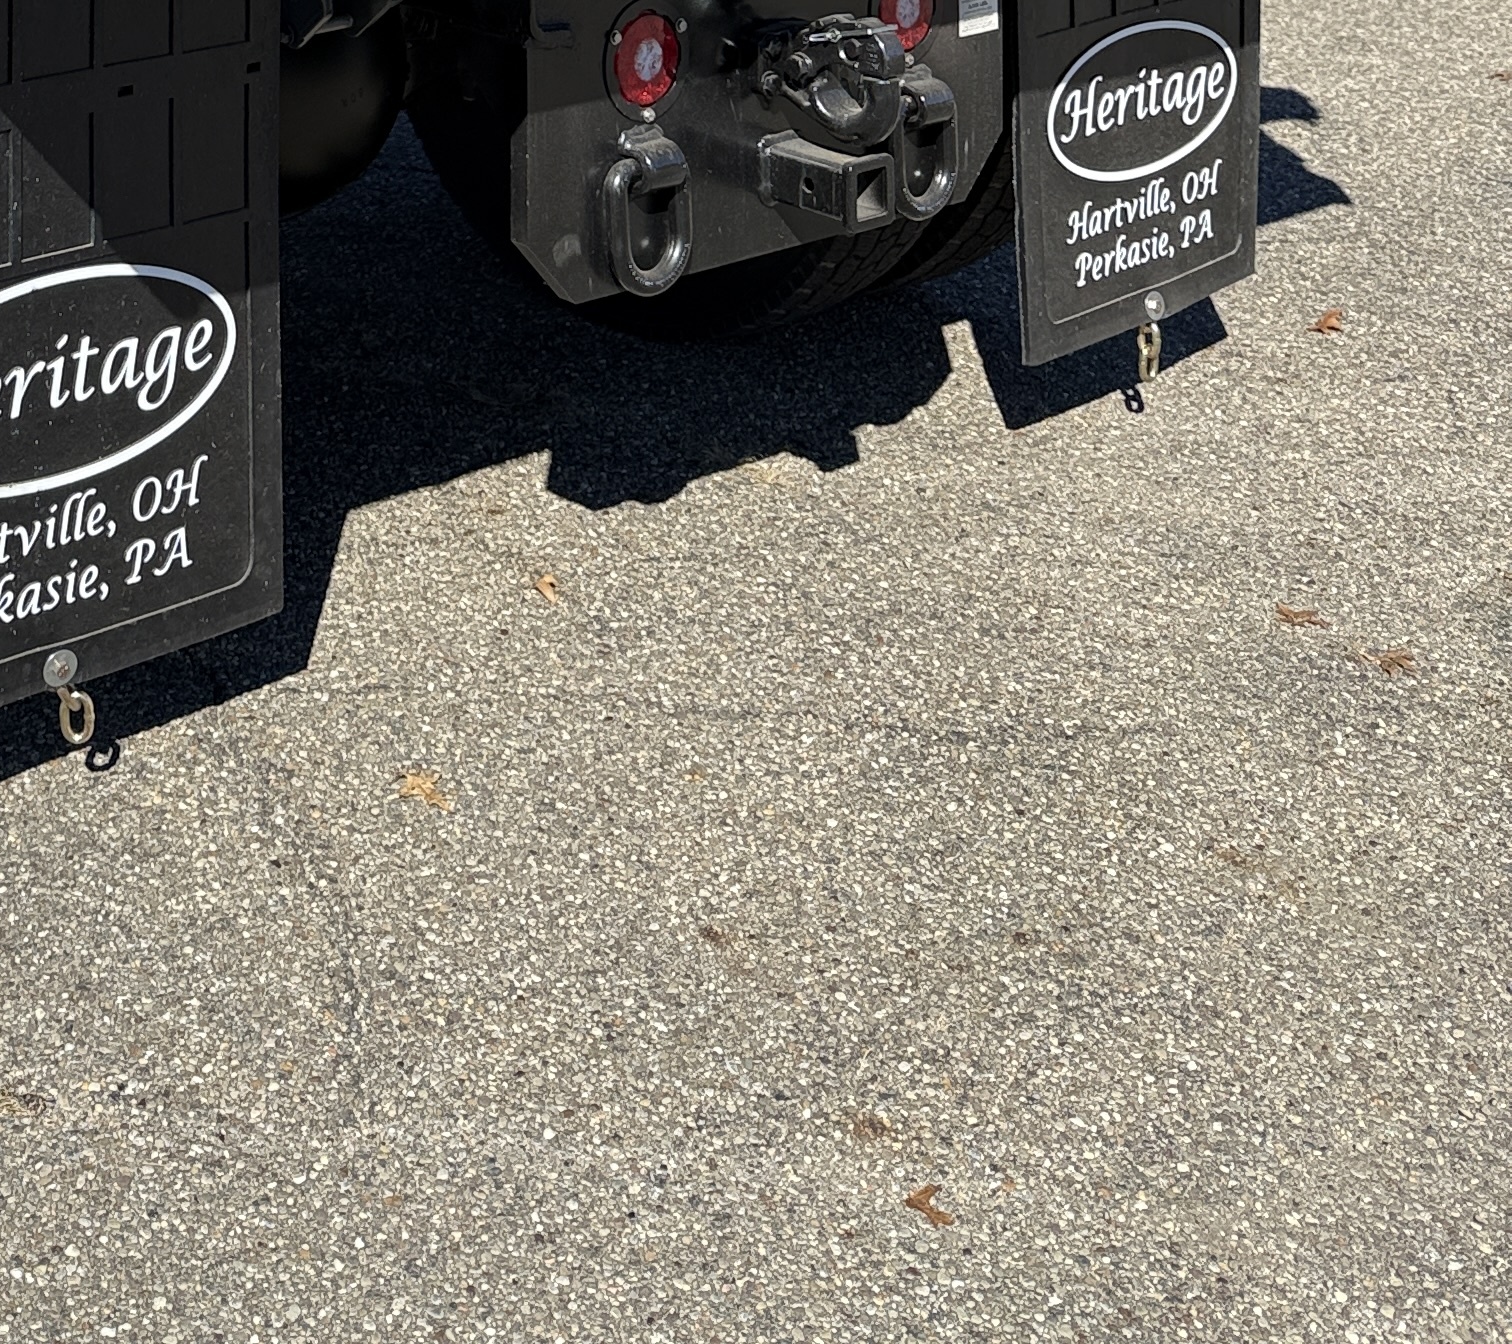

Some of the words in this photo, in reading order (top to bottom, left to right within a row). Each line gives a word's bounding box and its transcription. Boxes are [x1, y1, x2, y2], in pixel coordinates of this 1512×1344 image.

[1060, 61, 1225, 144] Heritage
[1065, 176, 1177, 245] Hartville,
[1181, 158, 1223, 205] OH
[1074, 226, 1176, 288] Perkasie,
[1179, 208, 1214, 249] PA
[132, 454, 209, 522] OH
[124, 525, 193, 585] PA
